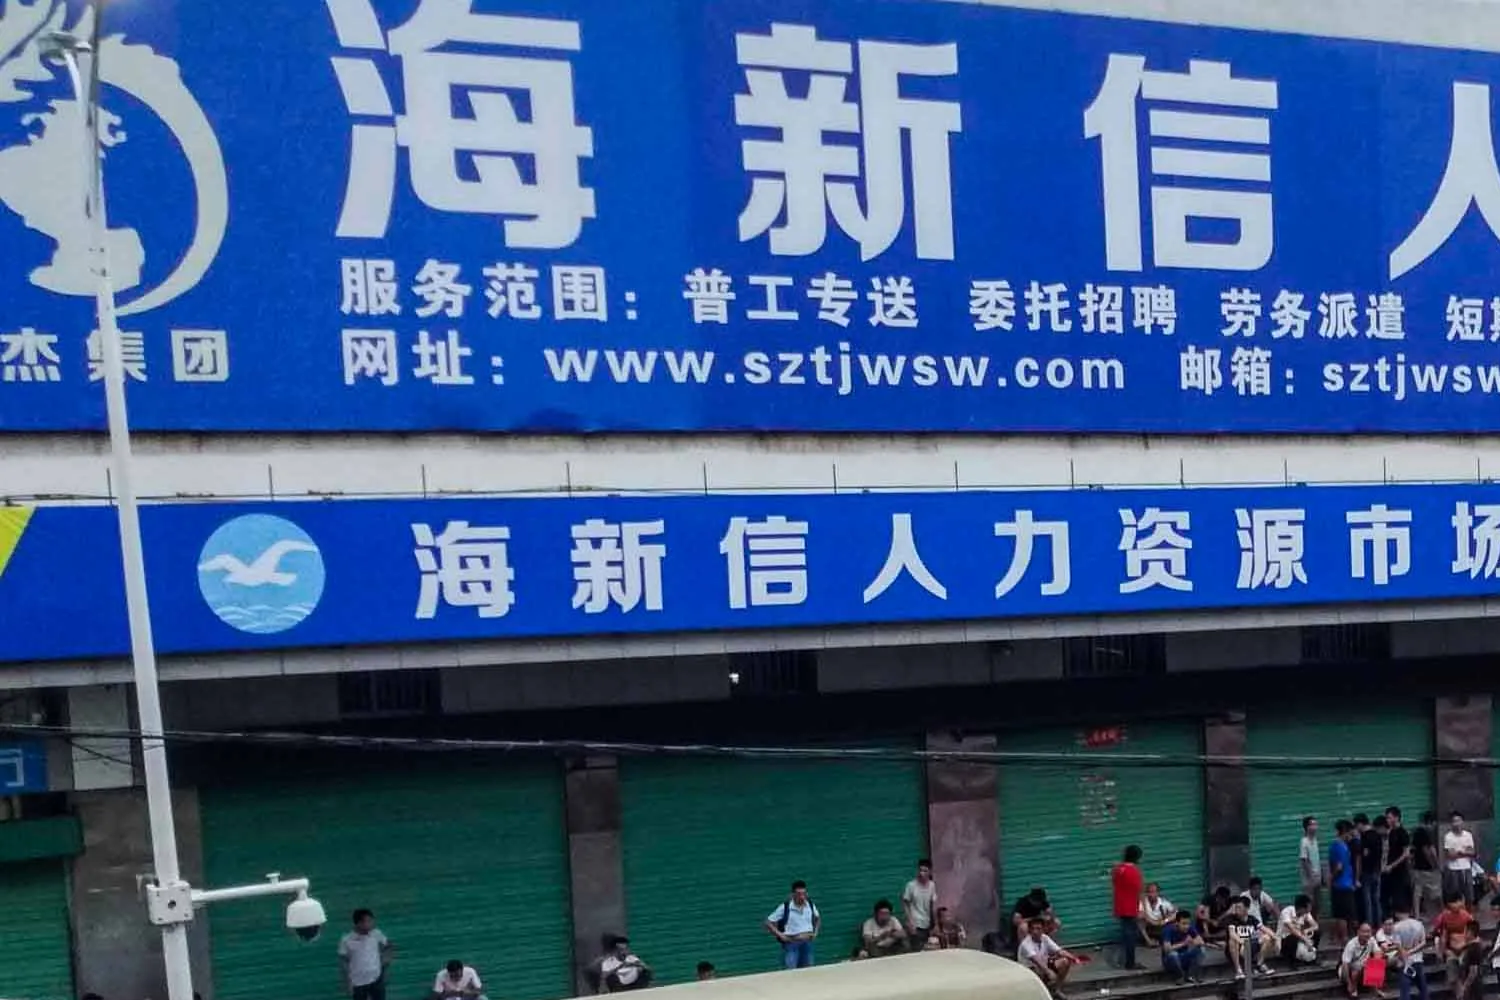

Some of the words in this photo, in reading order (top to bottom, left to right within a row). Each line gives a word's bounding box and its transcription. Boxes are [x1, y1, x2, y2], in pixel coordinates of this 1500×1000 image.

[969, 279, 1178, 335] 委托招聘
[1220, 287, 1406, 341] 劳务派遣
